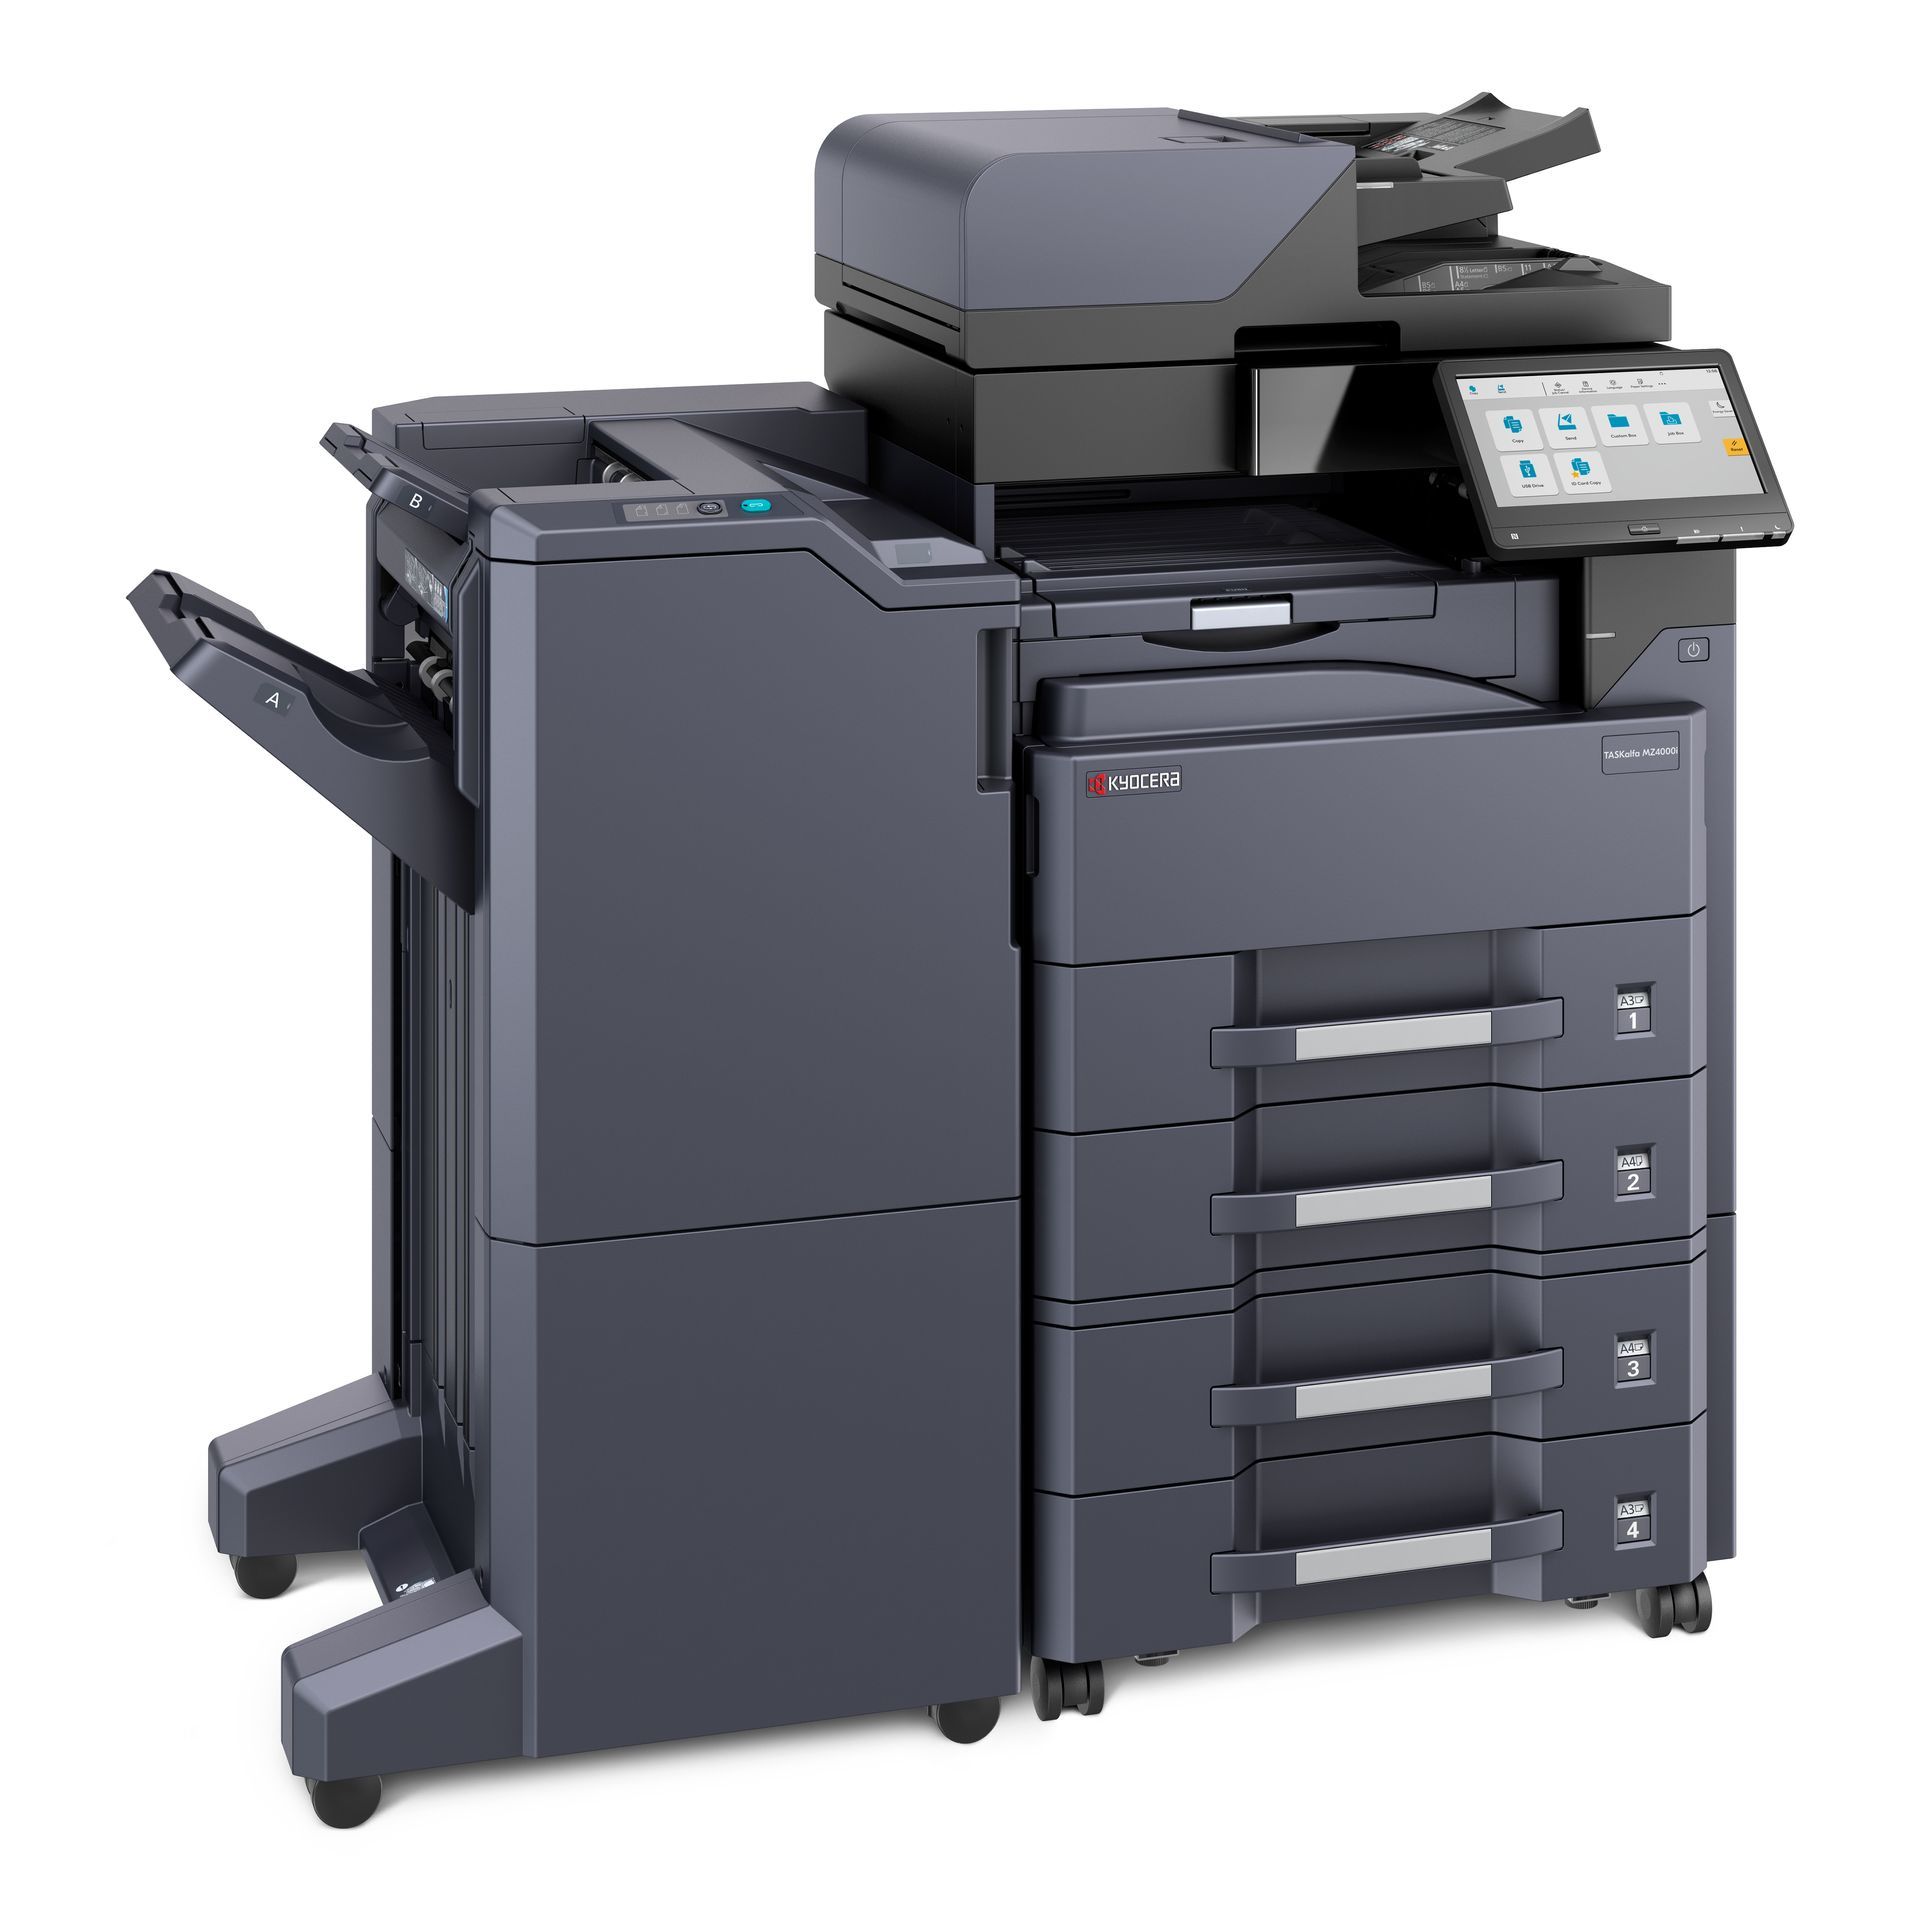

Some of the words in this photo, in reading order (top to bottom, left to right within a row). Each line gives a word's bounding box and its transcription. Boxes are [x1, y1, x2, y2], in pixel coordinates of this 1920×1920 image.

[409, 492, 423, 509] B
[265, 692, 279, 709] A
[1604, 749, 1640, 759] TASKalfa
[1642, 747, 1678, 757] MZ4000i
[1108, 772, 1180, 791] KYOCERA
[1620, 995, 1635, 1006] A3
[1629, 1011, 1637, 1030] 1
[1621, 1156, 1636, 1168] A4
[1627, 1173, 1640, 1191] 2
[1620, 1342, 1635, 1354] A4
[1627, 1360, 1640, 1377] 3
[1620, 1503, 1635, 1516] A3
[1626, 1521, 1640, 1539] 4
